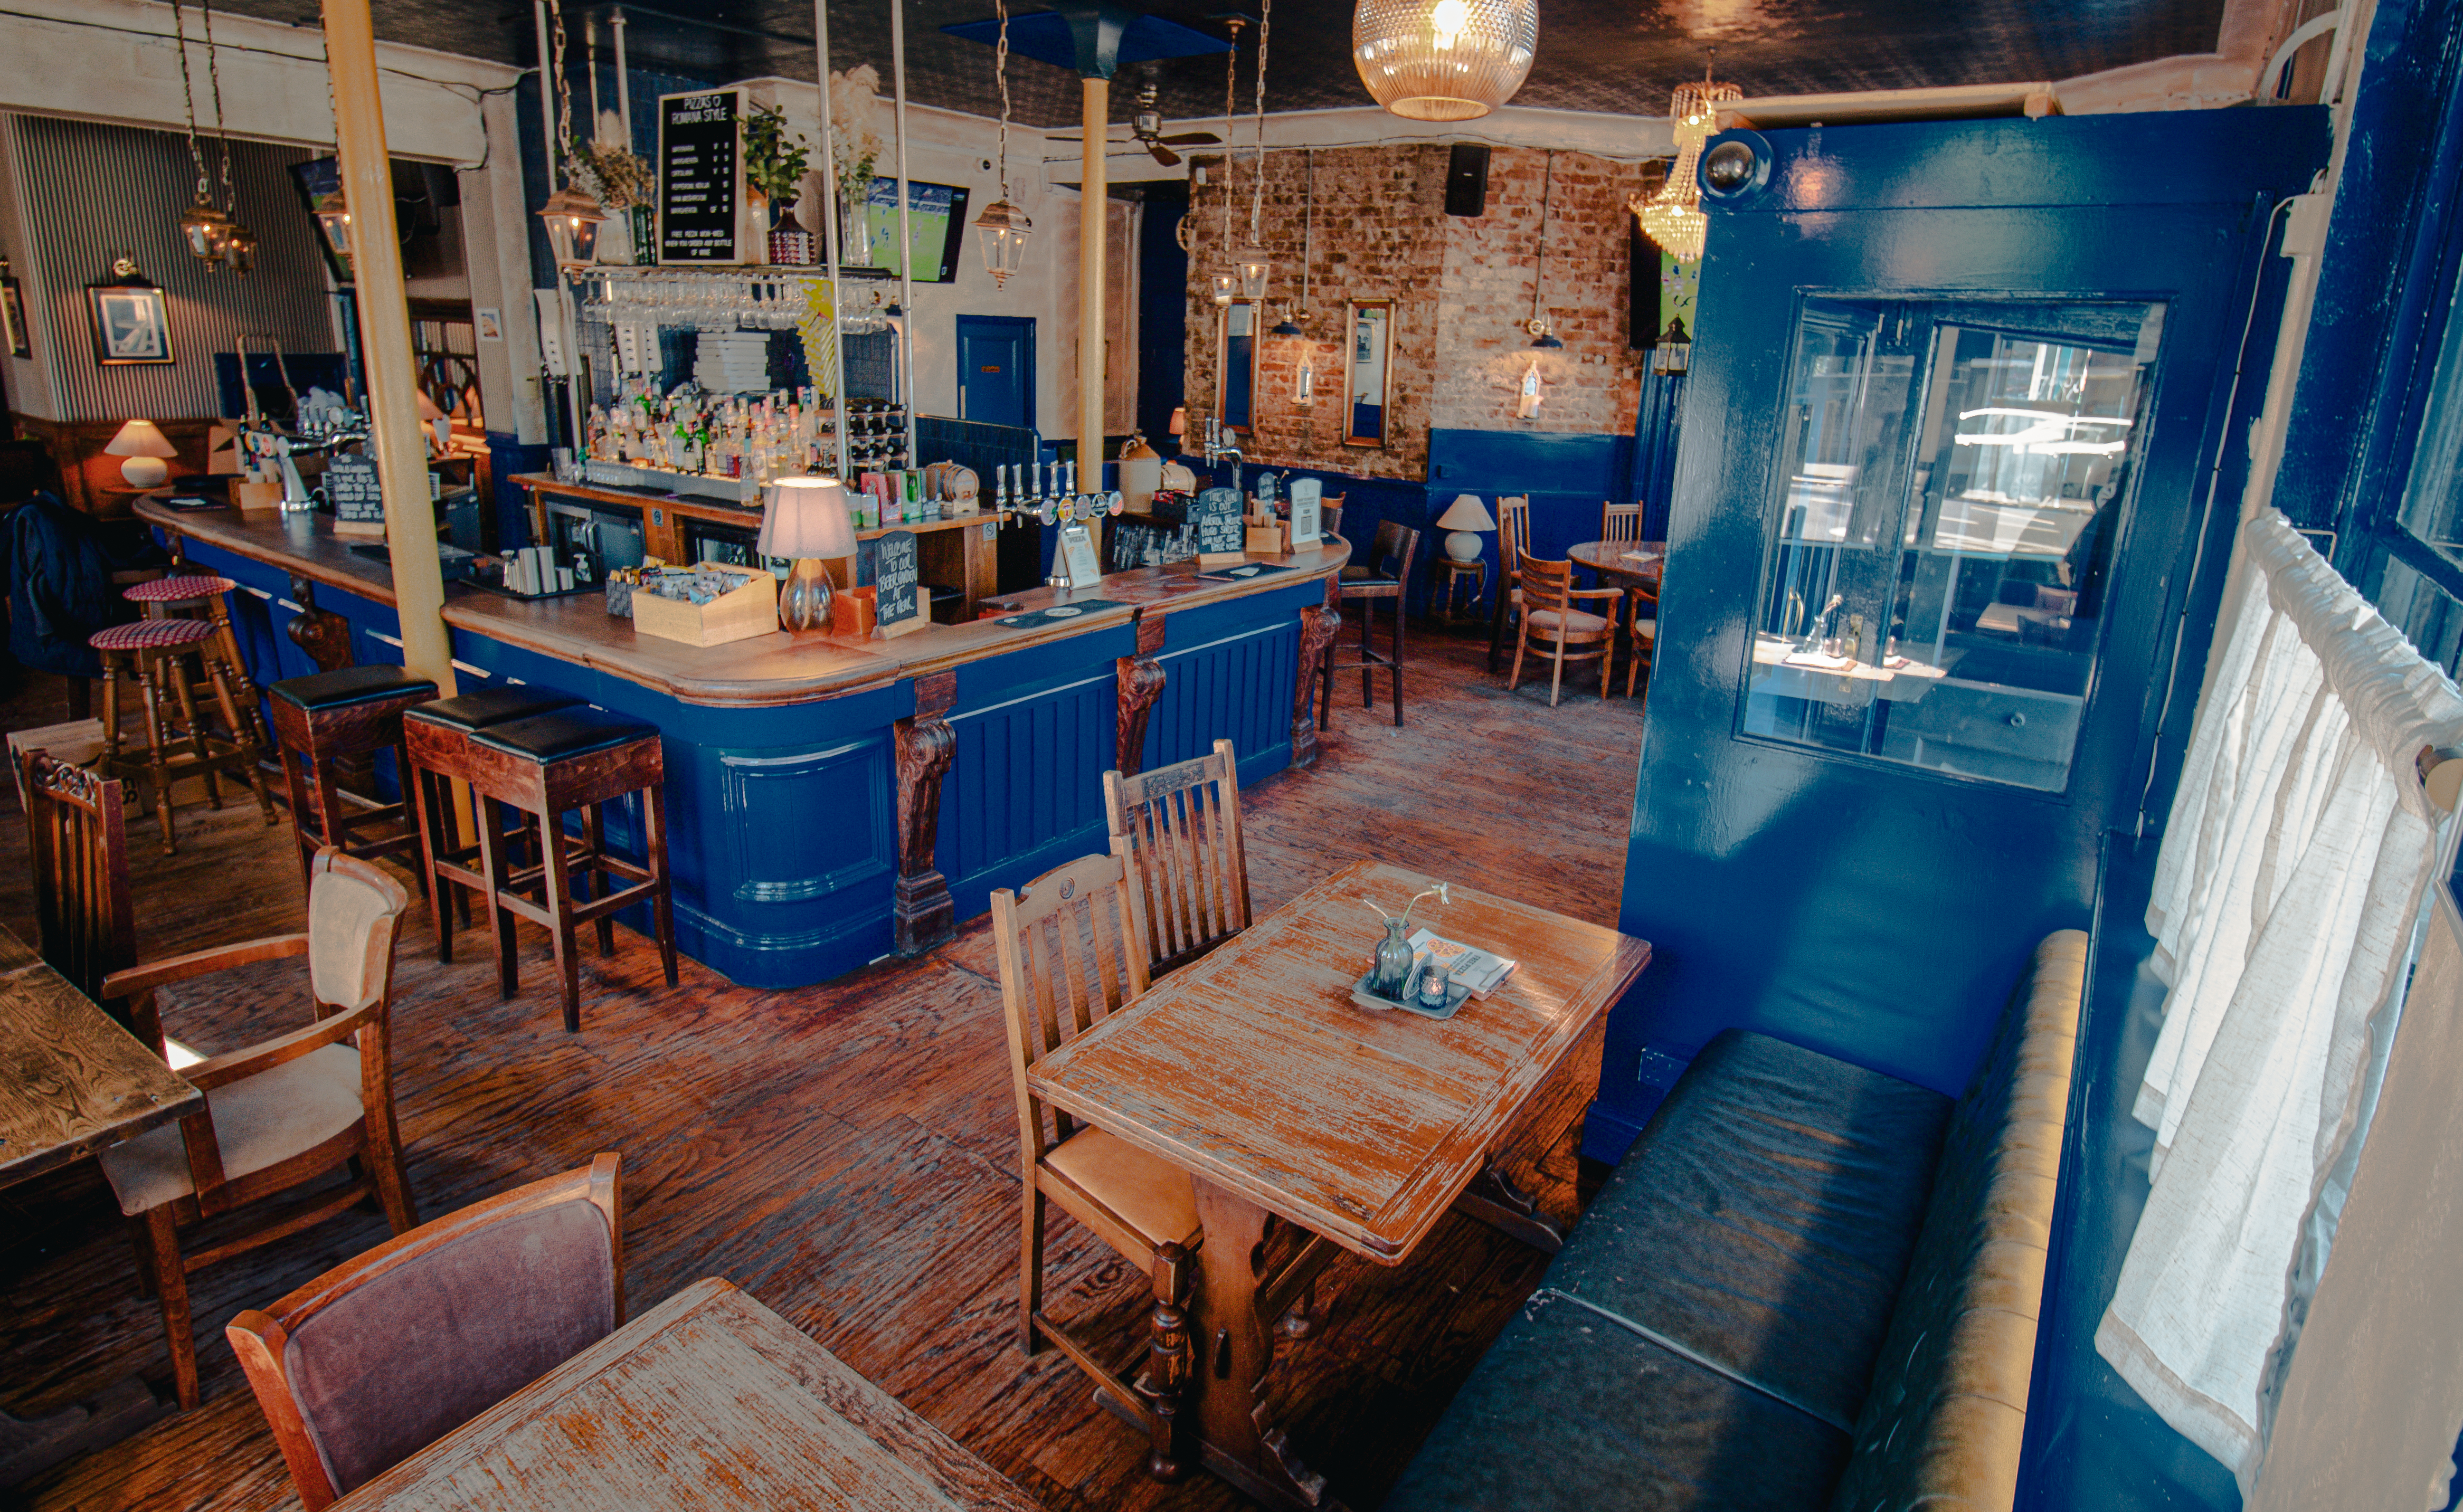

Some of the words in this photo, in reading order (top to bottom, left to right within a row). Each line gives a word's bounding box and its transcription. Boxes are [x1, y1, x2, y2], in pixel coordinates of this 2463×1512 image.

[703, 107, 728, 122] STYLE
[1206, 490, 1223, 502] THE
[1224, 490, 1237, 502] SUN
[1209, 502, 1217, 511] IS
[1219, 501, 1234, 511] OUT
[1201, 527, 1218, 537] HUGO
[881, 538, 913, 560] WELCOME
[878, 572, 898, 593] BEER
[879, 603, 896, 621] THE
[1466, 955, 1481, 965] FREE
